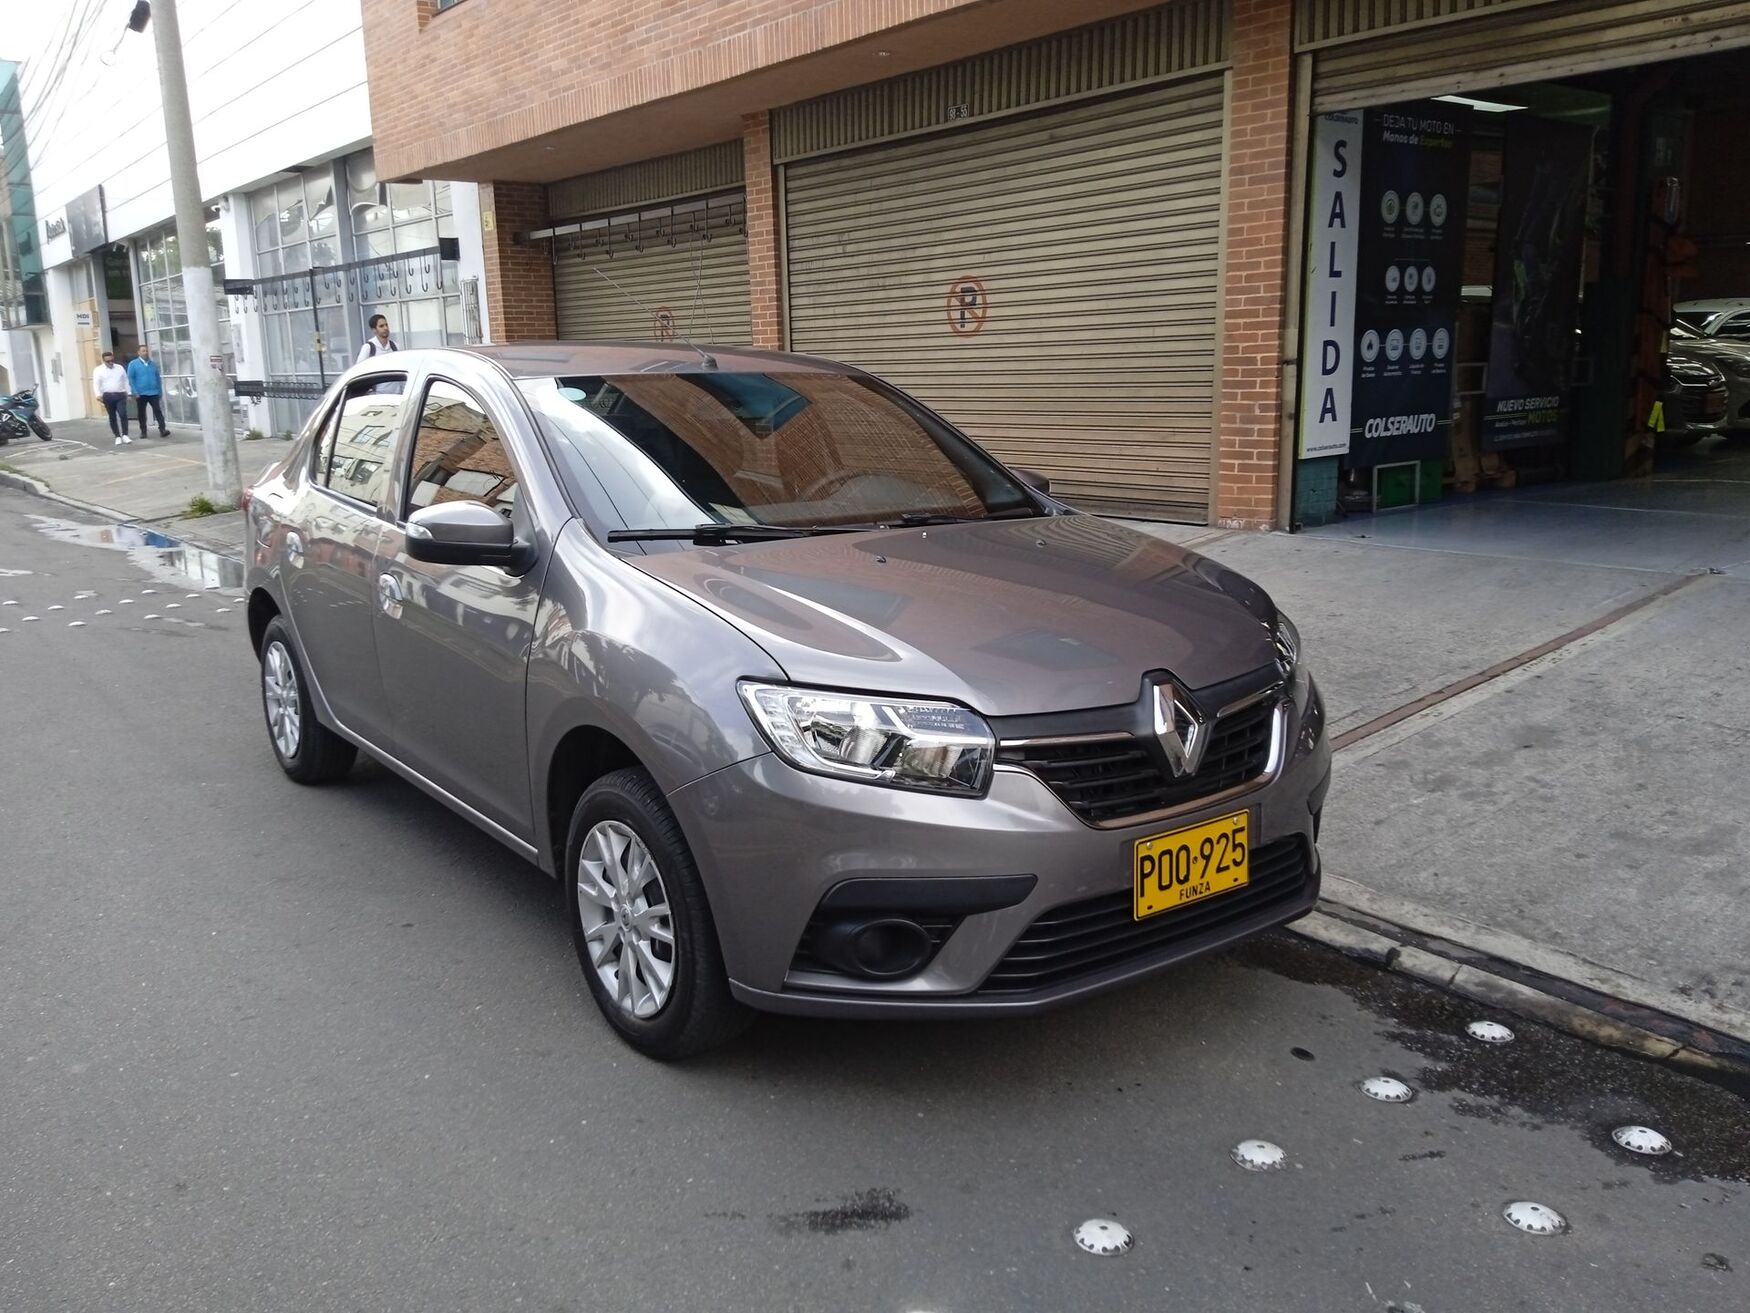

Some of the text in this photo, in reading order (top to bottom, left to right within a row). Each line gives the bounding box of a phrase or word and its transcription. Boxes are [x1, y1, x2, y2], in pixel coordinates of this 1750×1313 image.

[1407, 117, 1417, 131] TU
[1419, 119, 1442, 133] MOTO
[1319, 140, 1347, 424] SALIDA
[1496, 399, 1525, 412] NUEVO
[1364, 413, 1436, 438] COLSERAUTO
[1179, 881, 1211, 900] FUNZA
